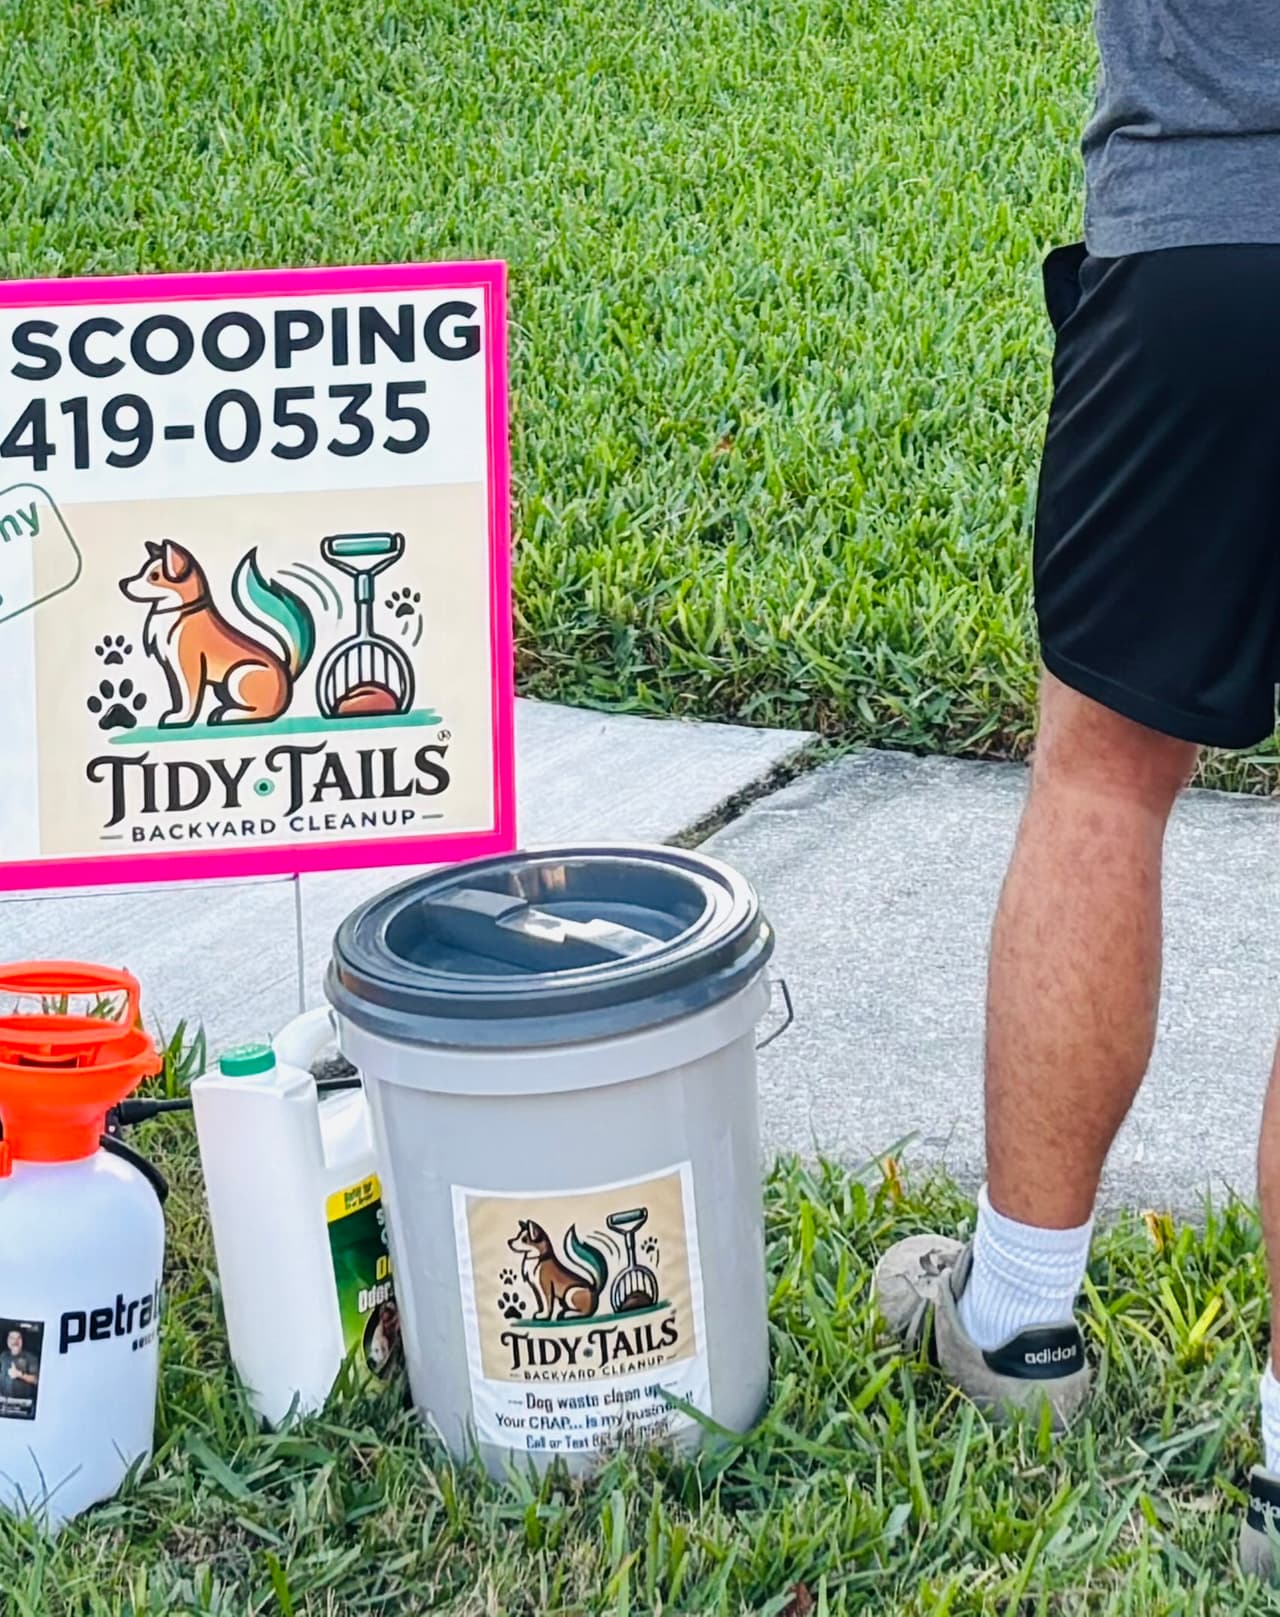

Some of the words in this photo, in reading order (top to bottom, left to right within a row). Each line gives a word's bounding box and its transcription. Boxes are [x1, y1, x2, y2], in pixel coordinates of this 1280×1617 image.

[11, 301, 482, 381] SCOOPING
[86, 749, 262, 827] TIDY
[265, 740, 451, 825] TAILS
[130, 815, 276, 843] BACKYARD
[289, 808, 416, 833] CLEANUP
[500, 1331, 582, 1370] TIDY
[588, 1317, 678, 1368] TAILS
[524, 1369, 595, 1381] BACKYARD
[602, 1356, 664, 1376] CLEANUP
[496, 1412, 527, 1428] Your
[526, 1392, 553, 1413] Dog
